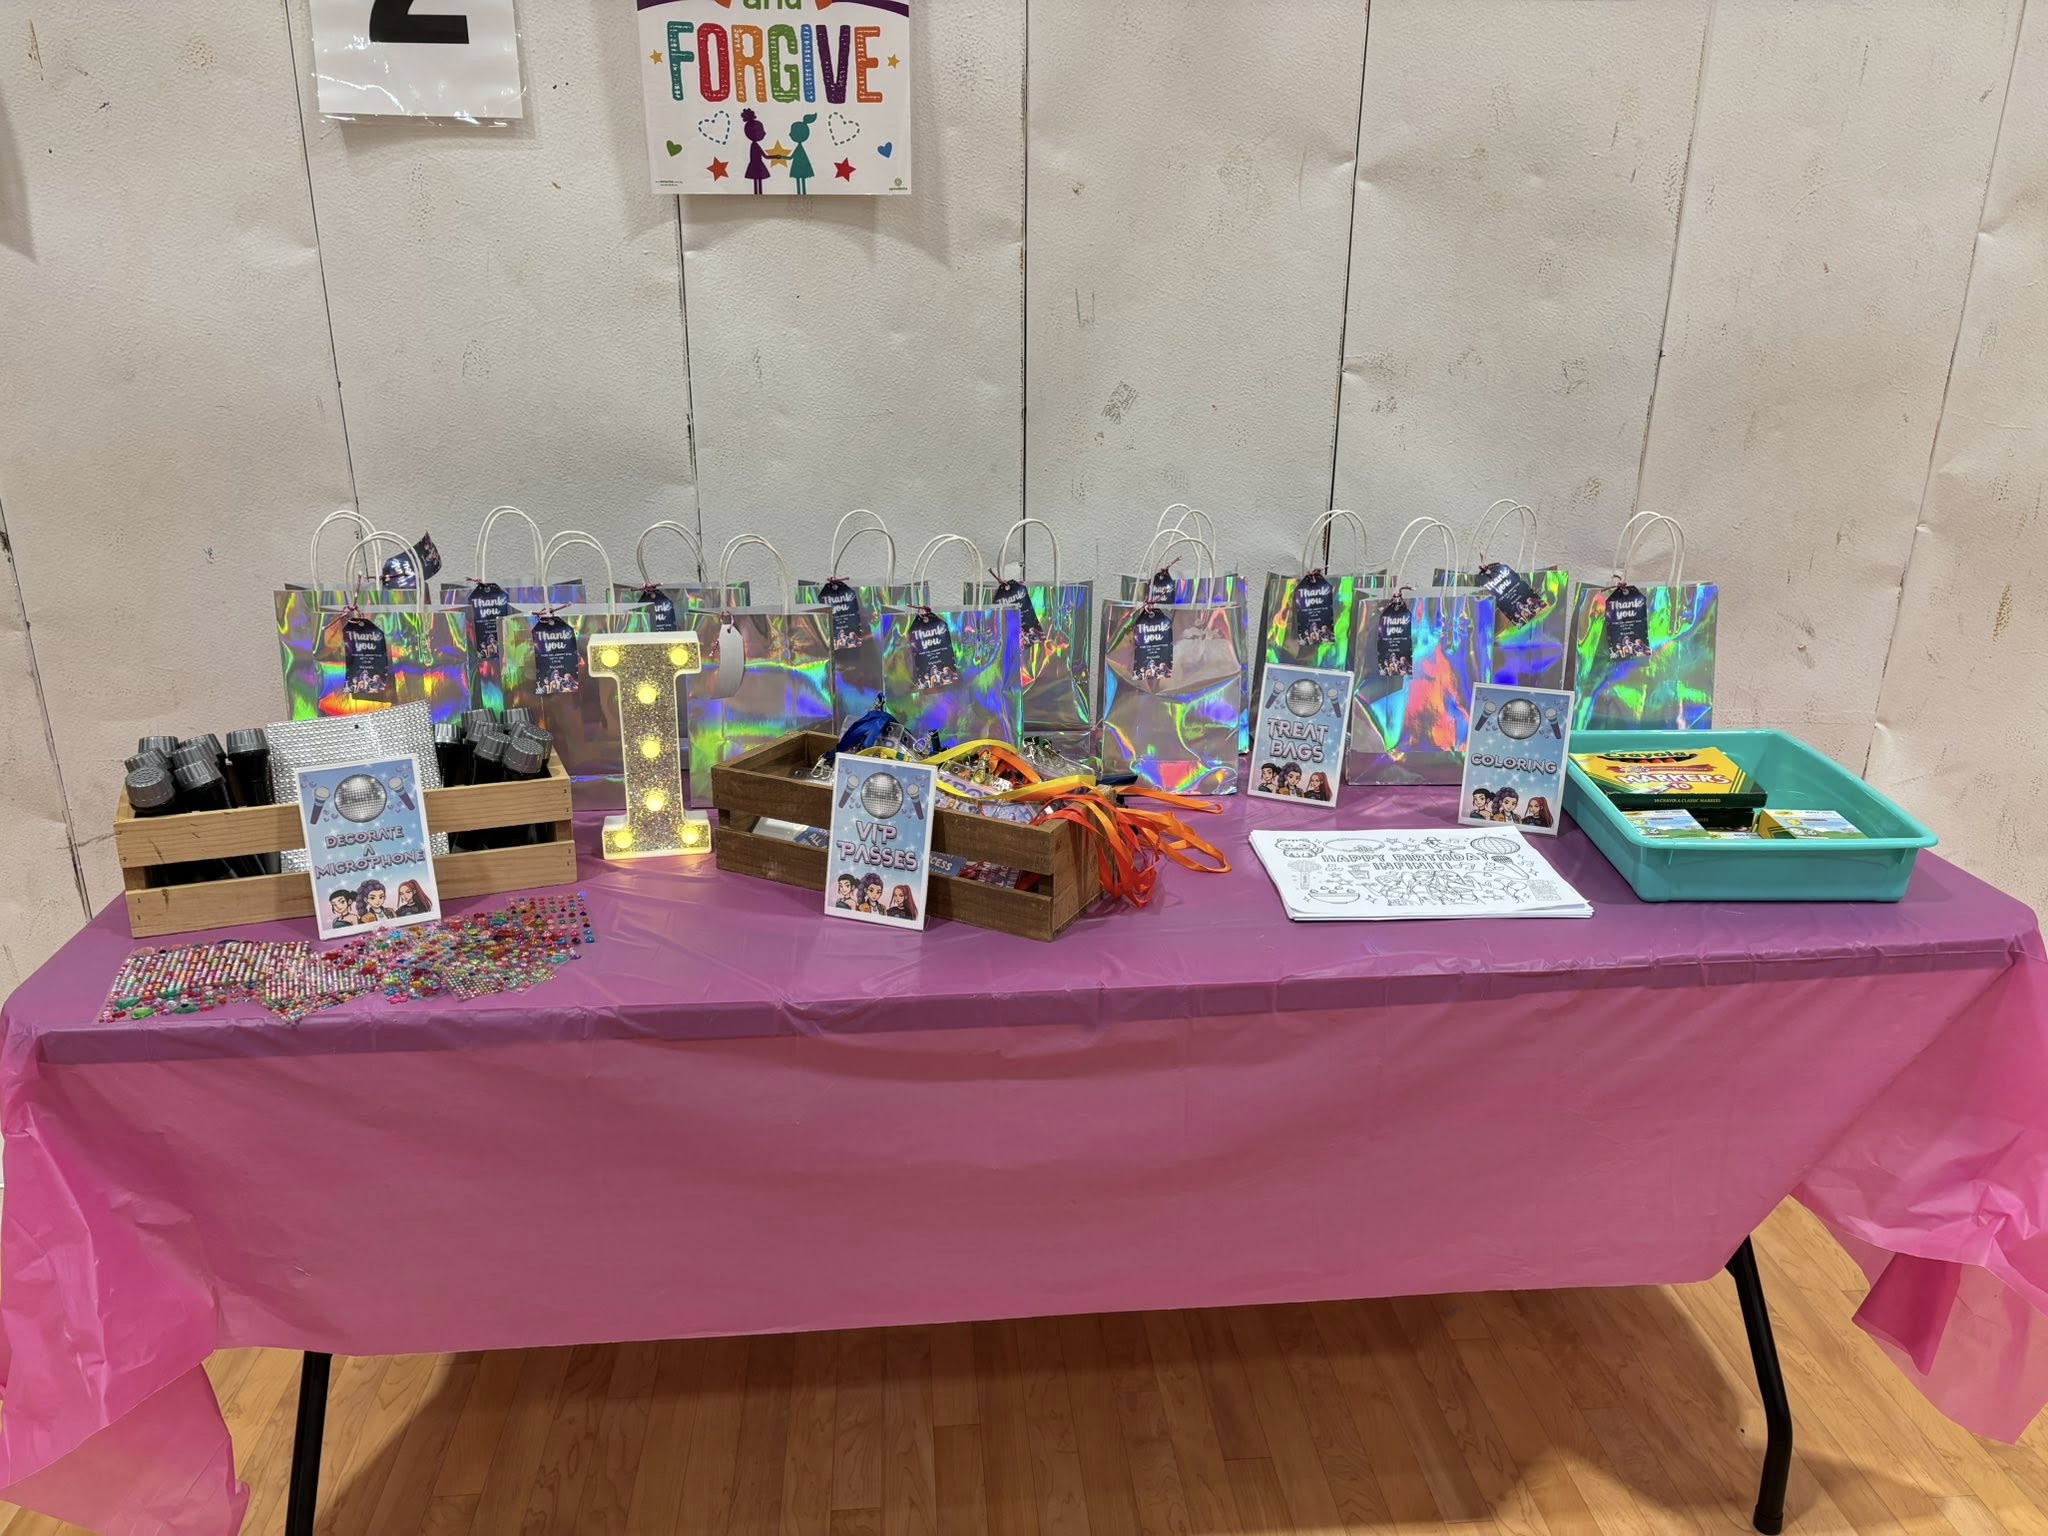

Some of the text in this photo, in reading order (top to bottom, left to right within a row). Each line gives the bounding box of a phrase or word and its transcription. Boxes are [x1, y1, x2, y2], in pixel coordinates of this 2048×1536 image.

[667, 21, 883, 104] FORGIVE
[1484, 568, 1510, 591] Thank
[1153, 584, 1174, 593] hank
[1298, 586, 1330, 598] Thank
[1496, 579, 1512, 595] you
[471, 595, 507, 608] Thank
[822, 592, 856, 604] Thank
[996, 589, 1026, 606] Thank
[1305, 597, 1324, 607] you
[1609, 598, 1645, 610] Thank
[479, 607, 500, 618] you
[1616, 610, 1637, 620] you
[1382, 615, 1410, 625] Thank
[912, 623, 947, 640] Thank
[1137, 621, 1171, 634] Thank
[1386, 626, 1404, 636] you
[345, 630, 383, 641] Thank
[536, 629, 573, 641] Thank
[1143, 633, 1163, 644] you
[355, 642, 377, 652] you
[544, 641, 567, 652] you
[921, 638, 942, 650] you
[1267, 717, 1329, 746] TREAT
[1270, 738, 1325, 764] BAGS
[1604, 750, 1687, 759] Crayola
[1470, 752, 1558, 776] COLORING
[1618, 773, 1732, 785] MARKERS
[324, 826, 405, 850] DECORATE
[855, 820, 897, 845] VIP
[363, 843, 376, 857] A
[836, 840, 919, 872] PASSES
[1321, 852, 1490, 863] HAPPY BIRTHDAY
[315, 850, 426, 880] MICROPHONE
[1372, 862, 1454, 870] INFINITI
